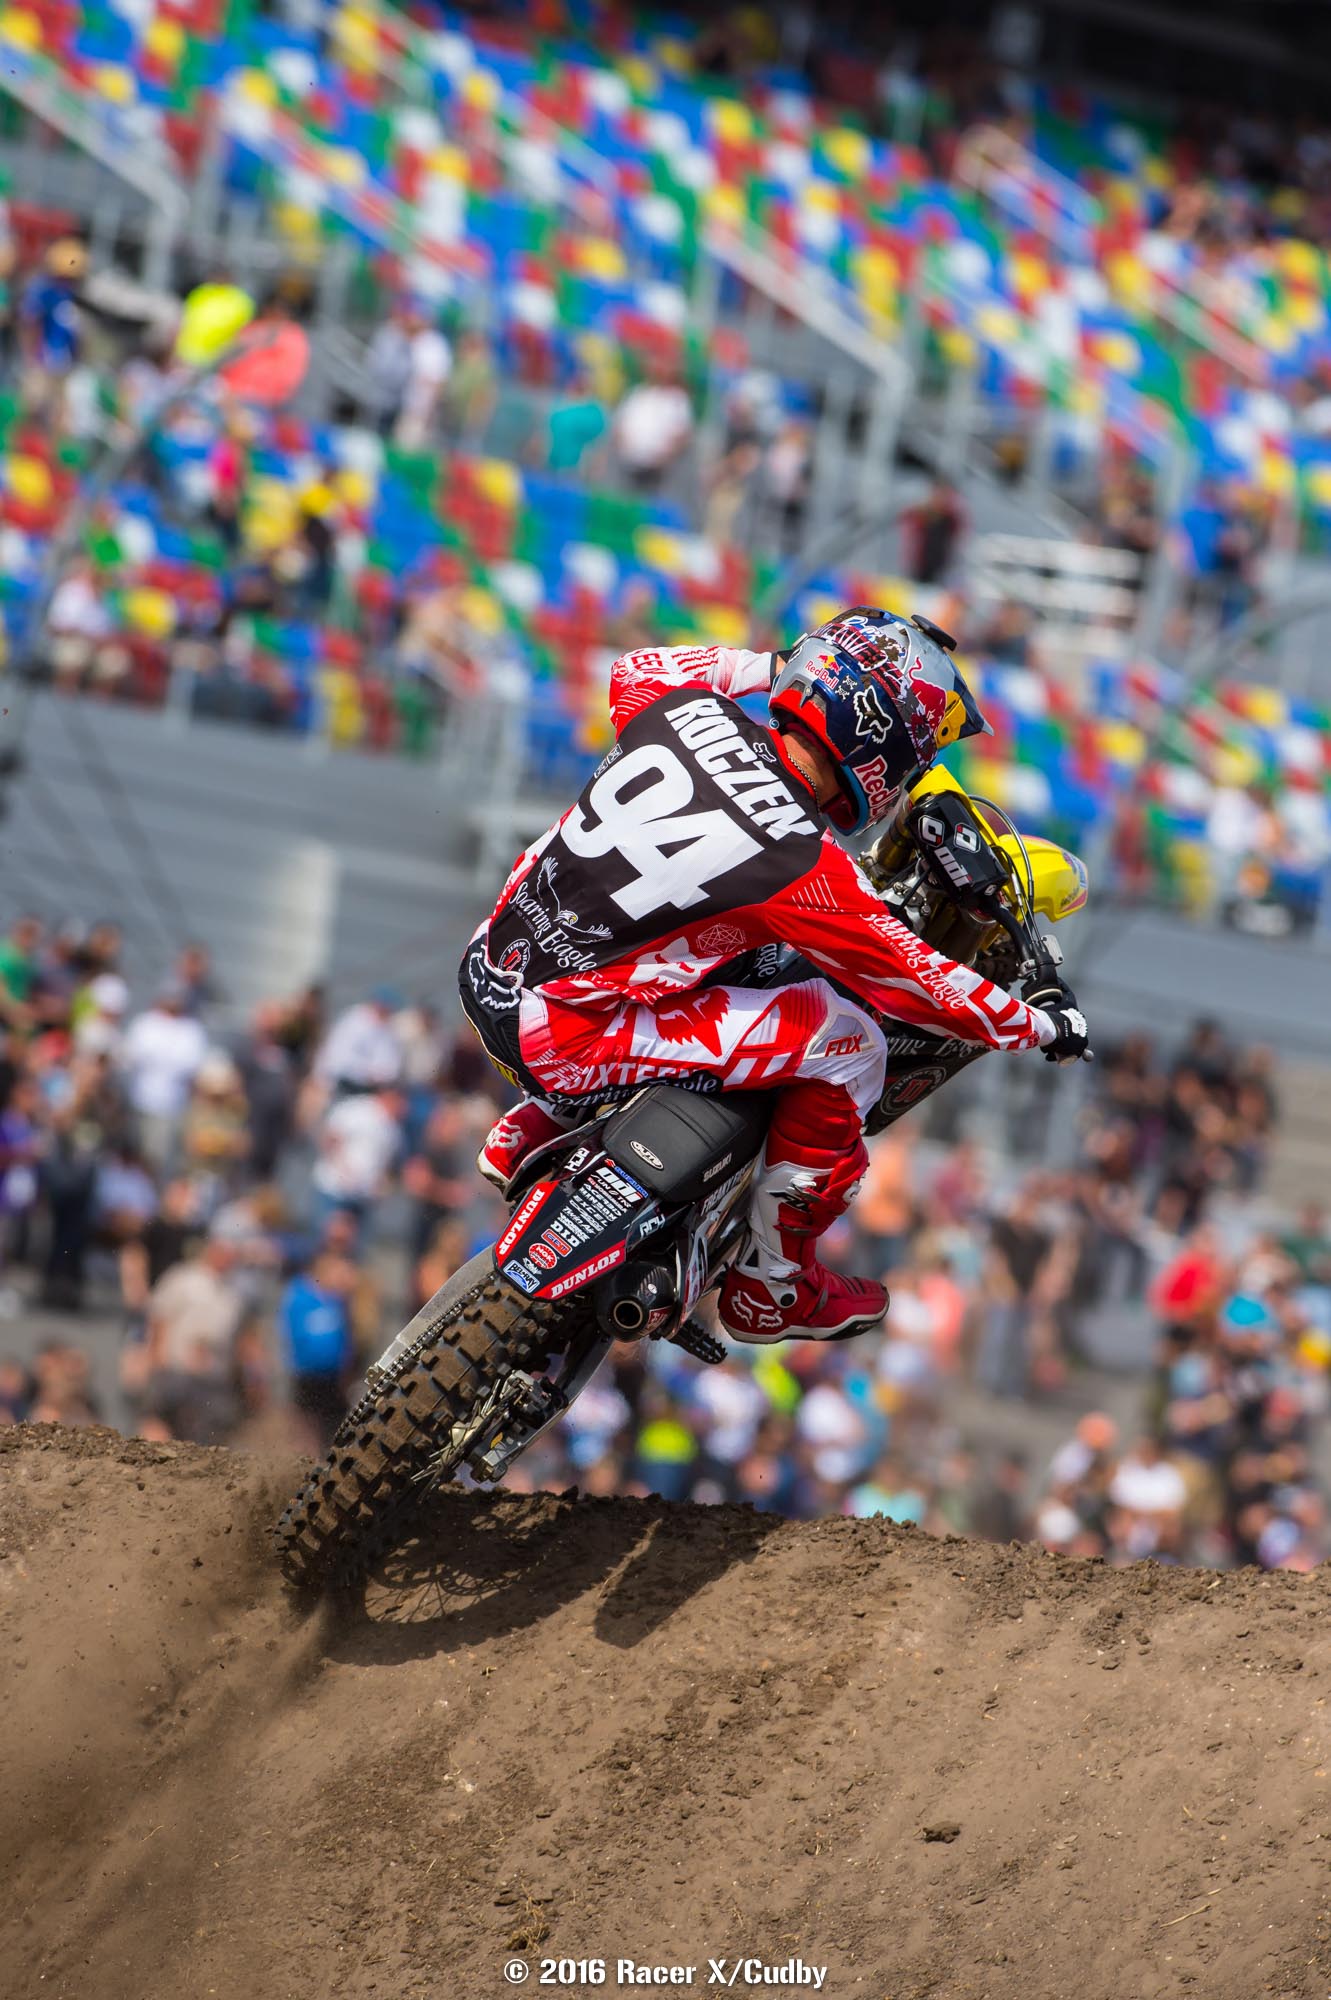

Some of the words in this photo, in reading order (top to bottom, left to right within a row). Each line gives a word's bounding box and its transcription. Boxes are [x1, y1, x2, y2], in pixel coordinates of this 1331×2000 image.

[664, 698, 818, 841] ROCZEN
[559, 744, 766, 921] 94
[508, 881, 552, 940] Soaring
[538, 927, 598, 971] Eagle
[916, 966, 967, 1010] Eagle
[824, 1033, 863, 1057] FOX
[564, 1147, 591, 1172] RCH
[498, 1188, 546, 1255] DUNLOP
[573, 1195, 608, 1227] EXCEL
[639, 1214, 666, 1238] RCH
[535, 1245, 555, 1262] NGK
[551, 1250, 621, 1298] DUNLOP
